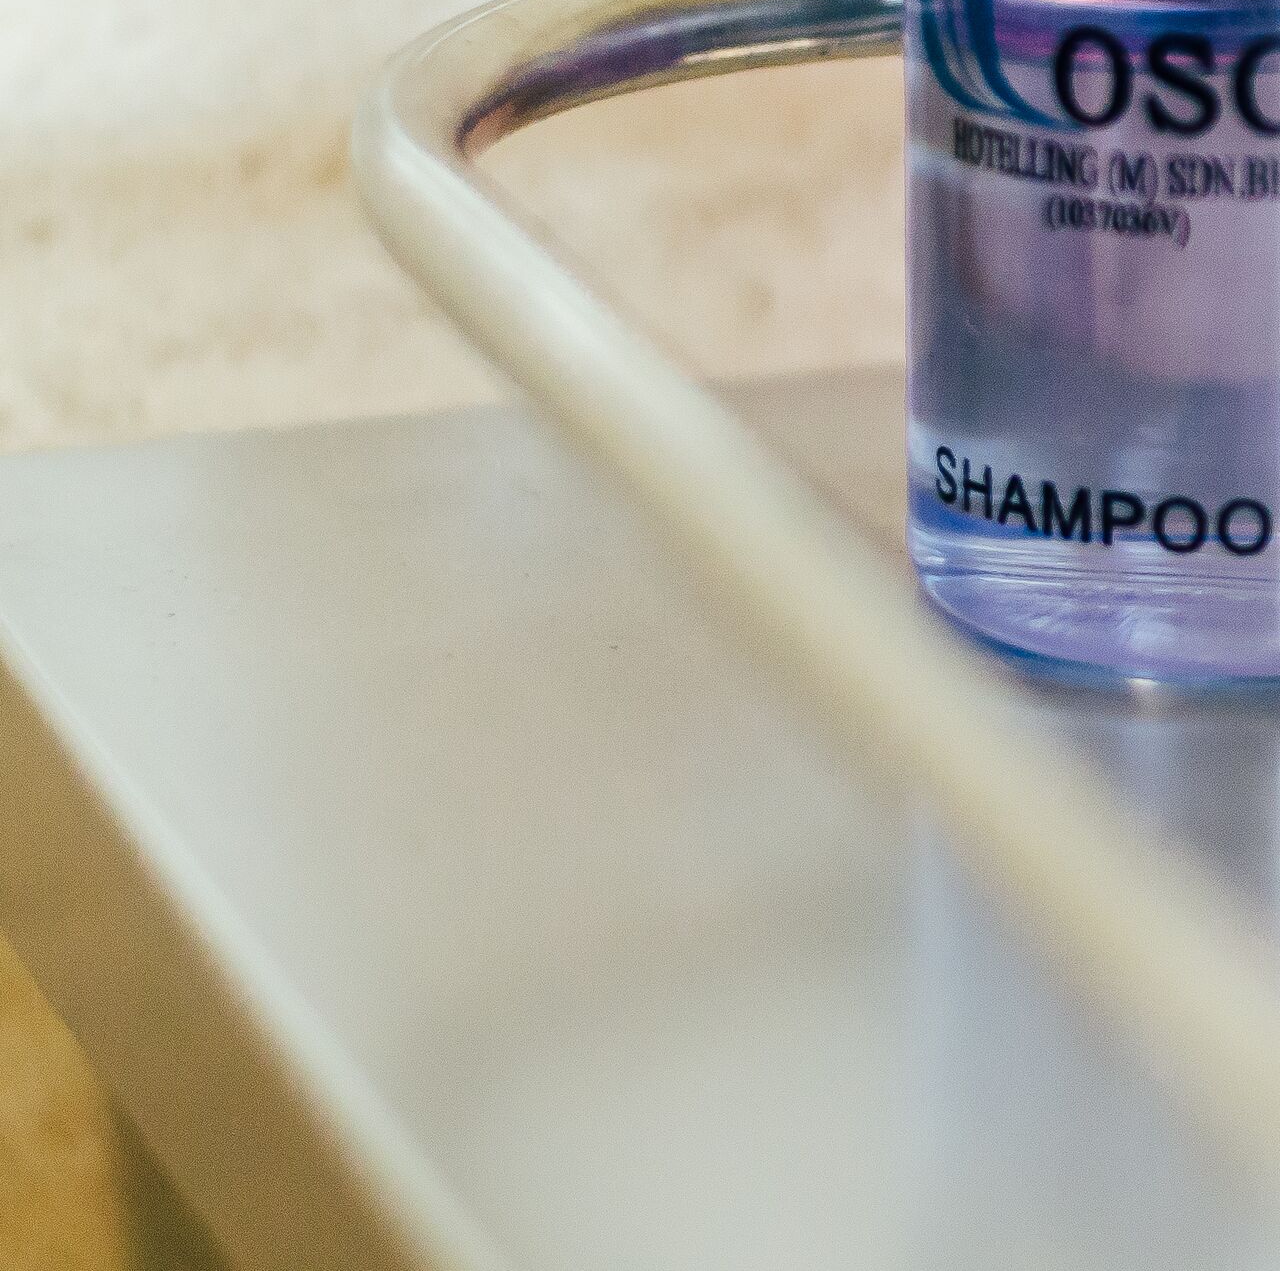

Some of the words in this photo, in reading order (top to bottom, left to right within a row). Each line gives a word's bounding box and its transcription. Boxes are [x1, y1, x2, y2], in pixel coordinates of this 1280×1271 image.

[953, 115, 1099, 188] HOTELLING
[1107, 148, 1158, 201] (M)
[934, 445, 1274, 558] SHAMPOO
